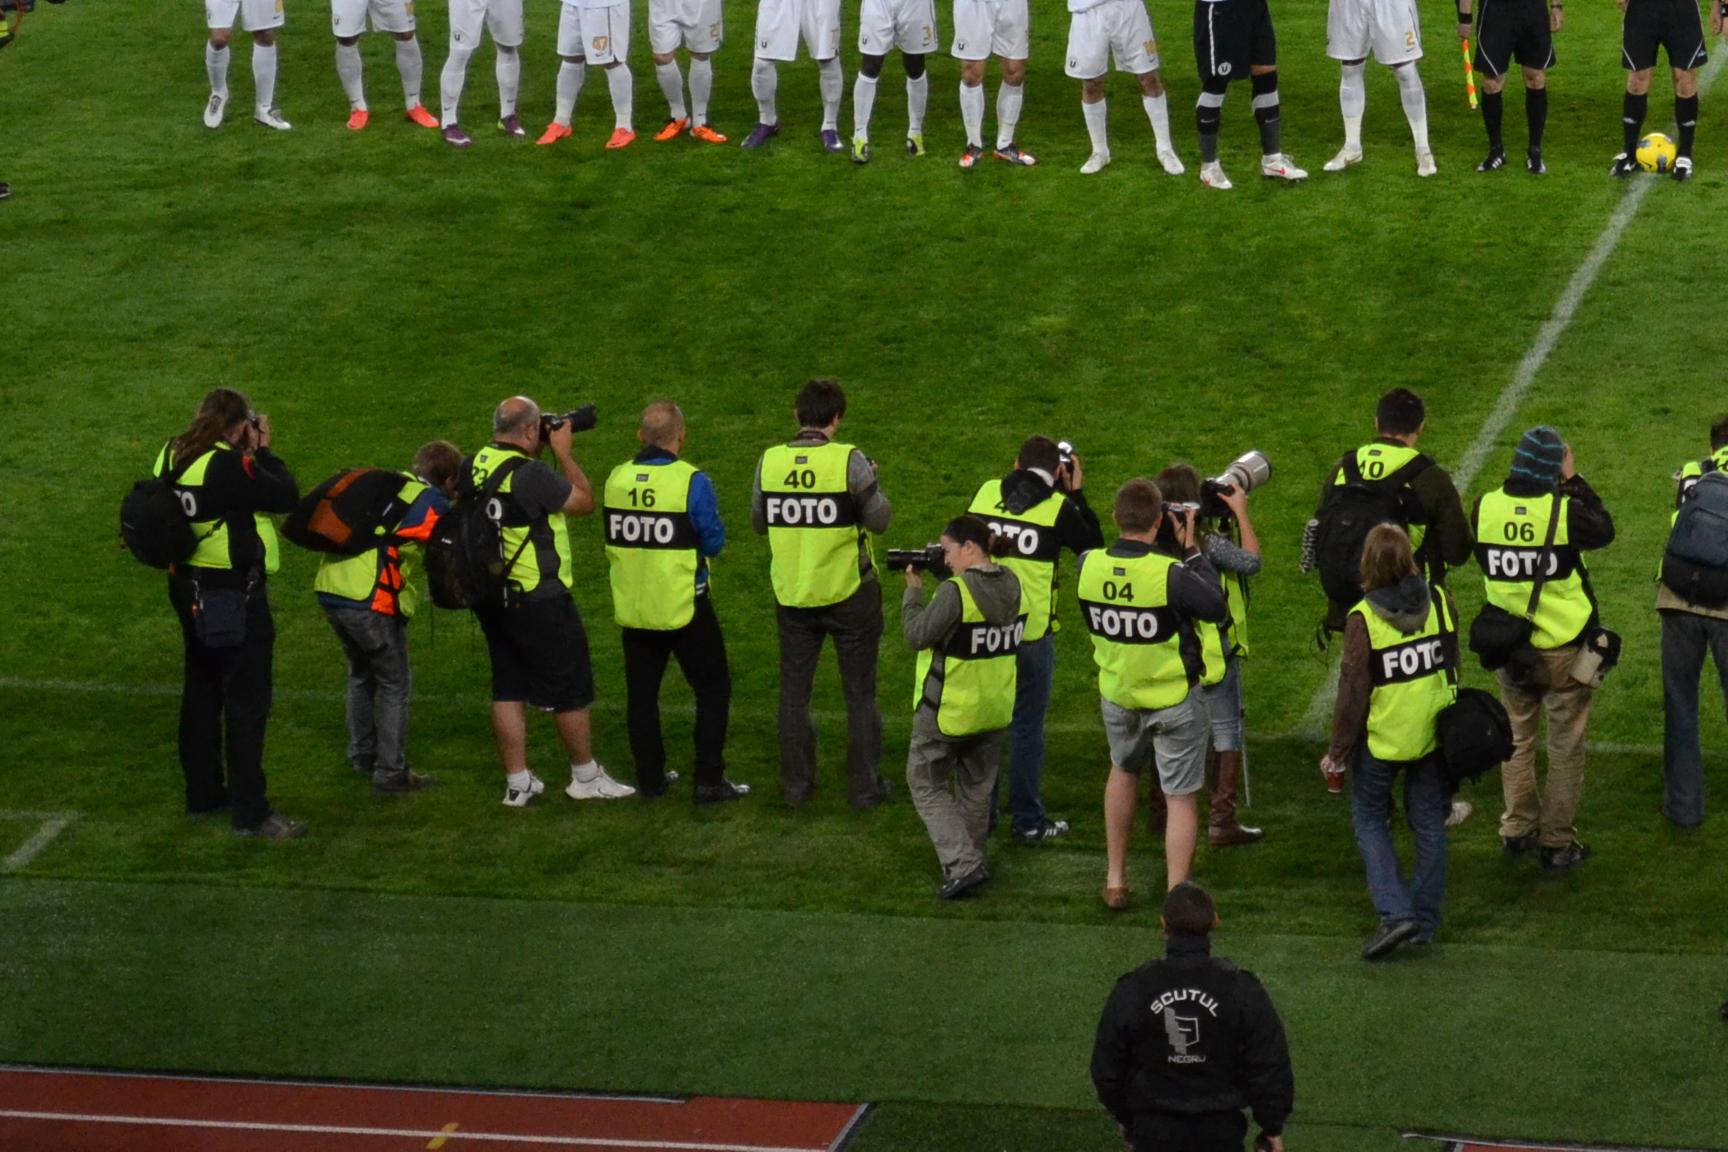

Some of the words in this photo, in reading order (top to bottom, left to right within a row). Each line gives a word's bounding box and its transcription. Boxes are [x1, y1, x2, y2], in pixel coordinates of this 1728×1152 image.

[784, 469, 816, 490] 40
[627, 488, 656, 508] 16
[766, 498, 838, 525] FOTO
[609, 514, 674, 543] FOTO
[1503, 521, 1535, 542] 06
[1488, 549, 1558, 577] FOTO
[1102, 581, 1134, 602] 04
[1088, 607, 1158, 639] FOTO
[970, 621, 1024, 654] FOTO
[1150, 989, 1221, 1018] SCUTUL
[1167, 1055, 1206, 1064] NEGRU
